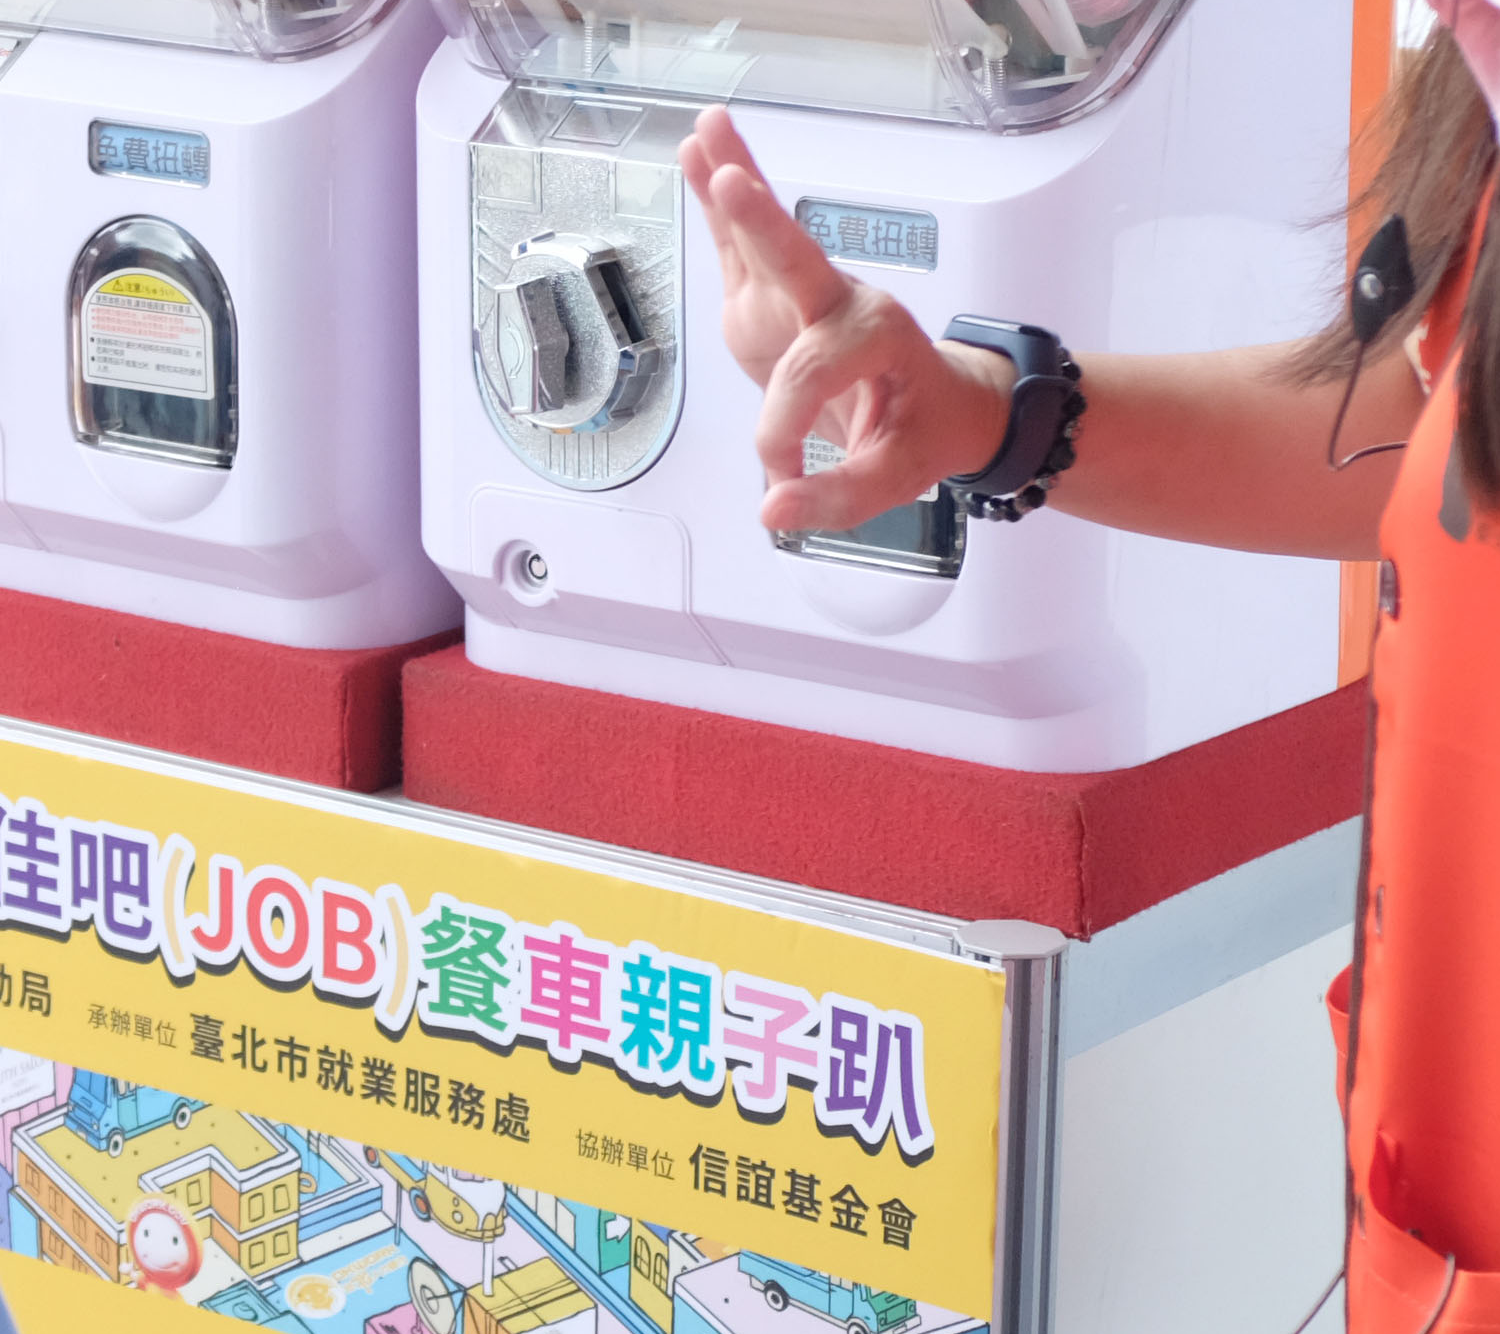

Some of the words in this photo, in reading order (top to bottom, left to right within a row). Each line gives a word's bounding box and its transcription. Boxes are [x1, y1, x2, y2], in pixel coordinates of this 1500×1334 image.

[97, 134, 210, 179] 免費扭轉
[806, 210, 938, 263] 免費扭轉
[86, 1003, 179, 1050] 承辦單位
[189, 1011, 532, 1144] 臺北市就業服務處
[575, 1128, 676, 1182] 協辦單位
[688, 1142, 918, 1251] 信誼基金會
